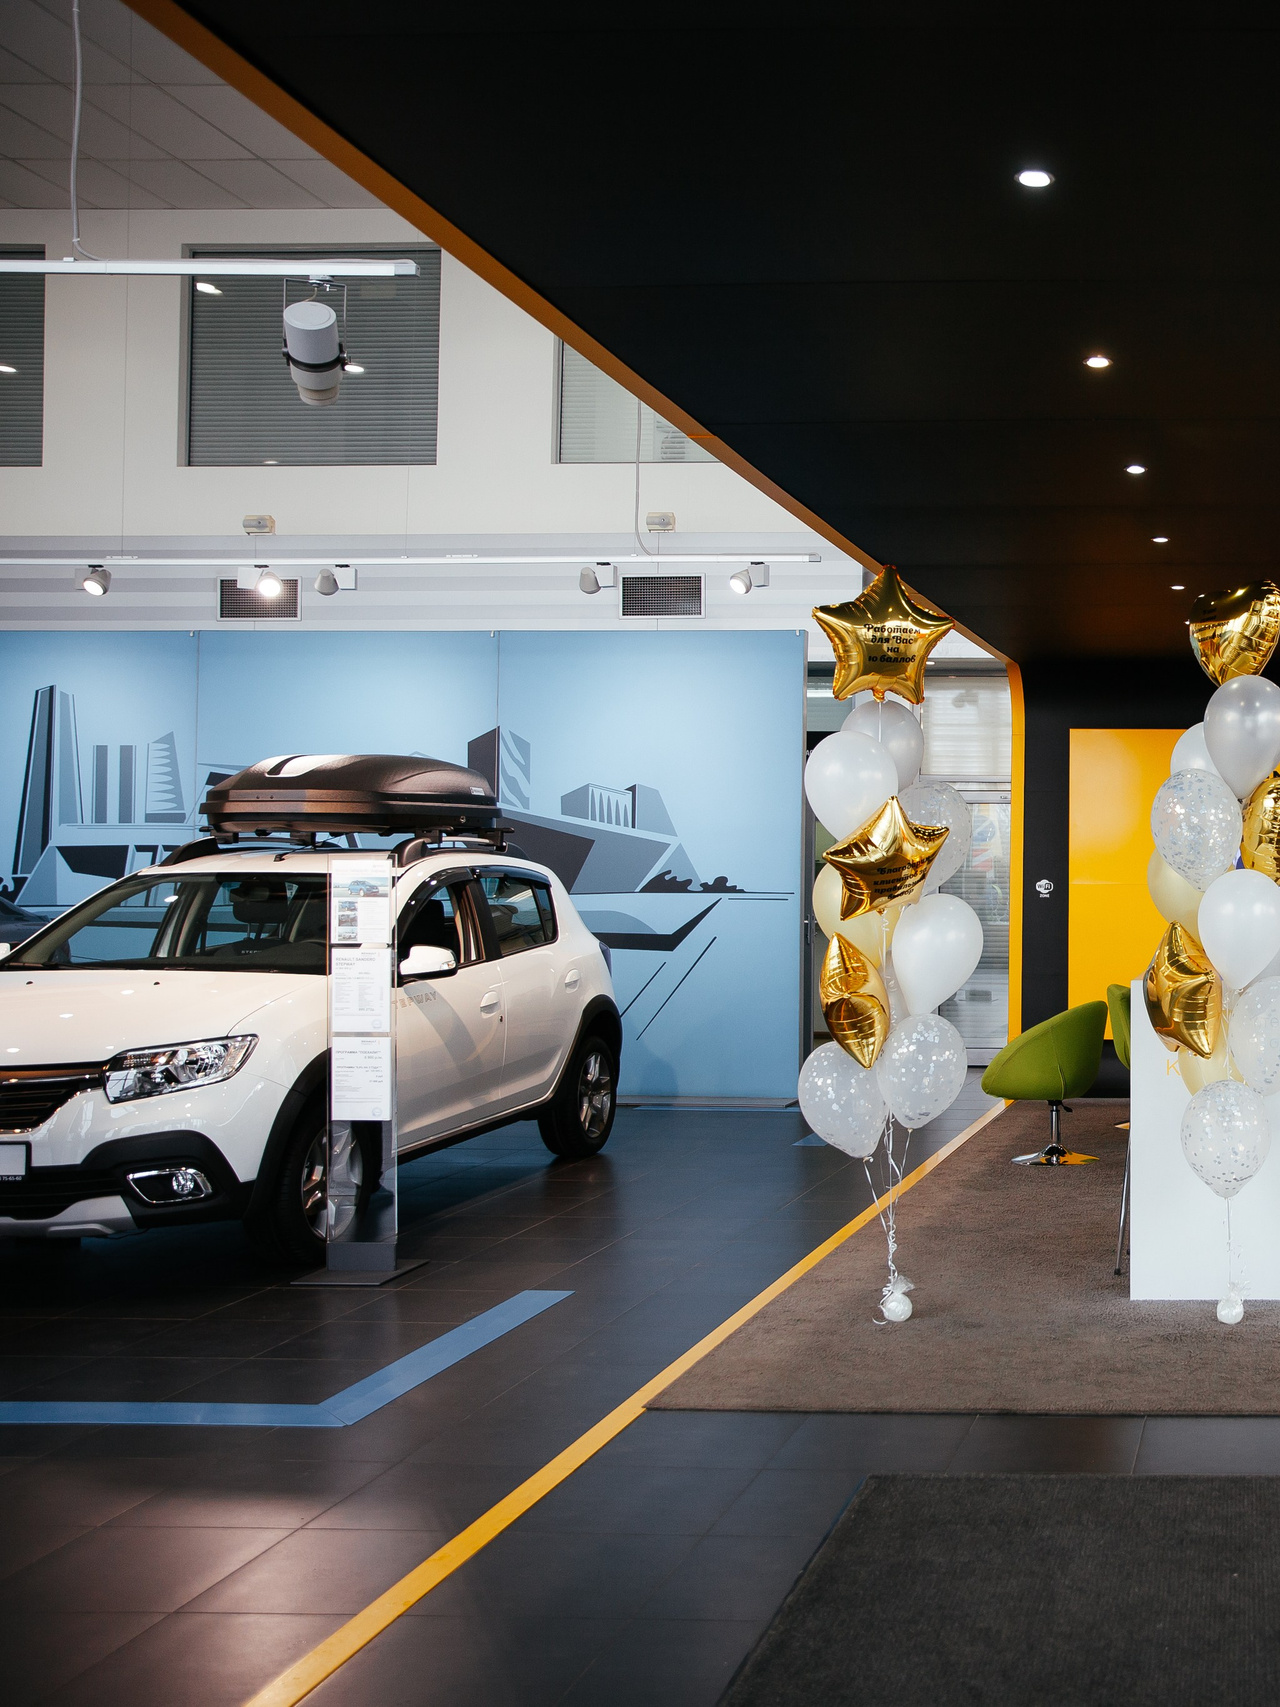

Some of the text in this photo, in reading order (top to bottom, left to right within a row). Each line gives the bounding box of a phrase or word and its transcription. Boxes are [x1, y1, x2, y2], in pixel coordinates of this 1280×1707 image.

[863, 623, 921, 635] Работаем
[871, 635, 914, 645] для Вас
[879, 654, 916, 663] баллов
